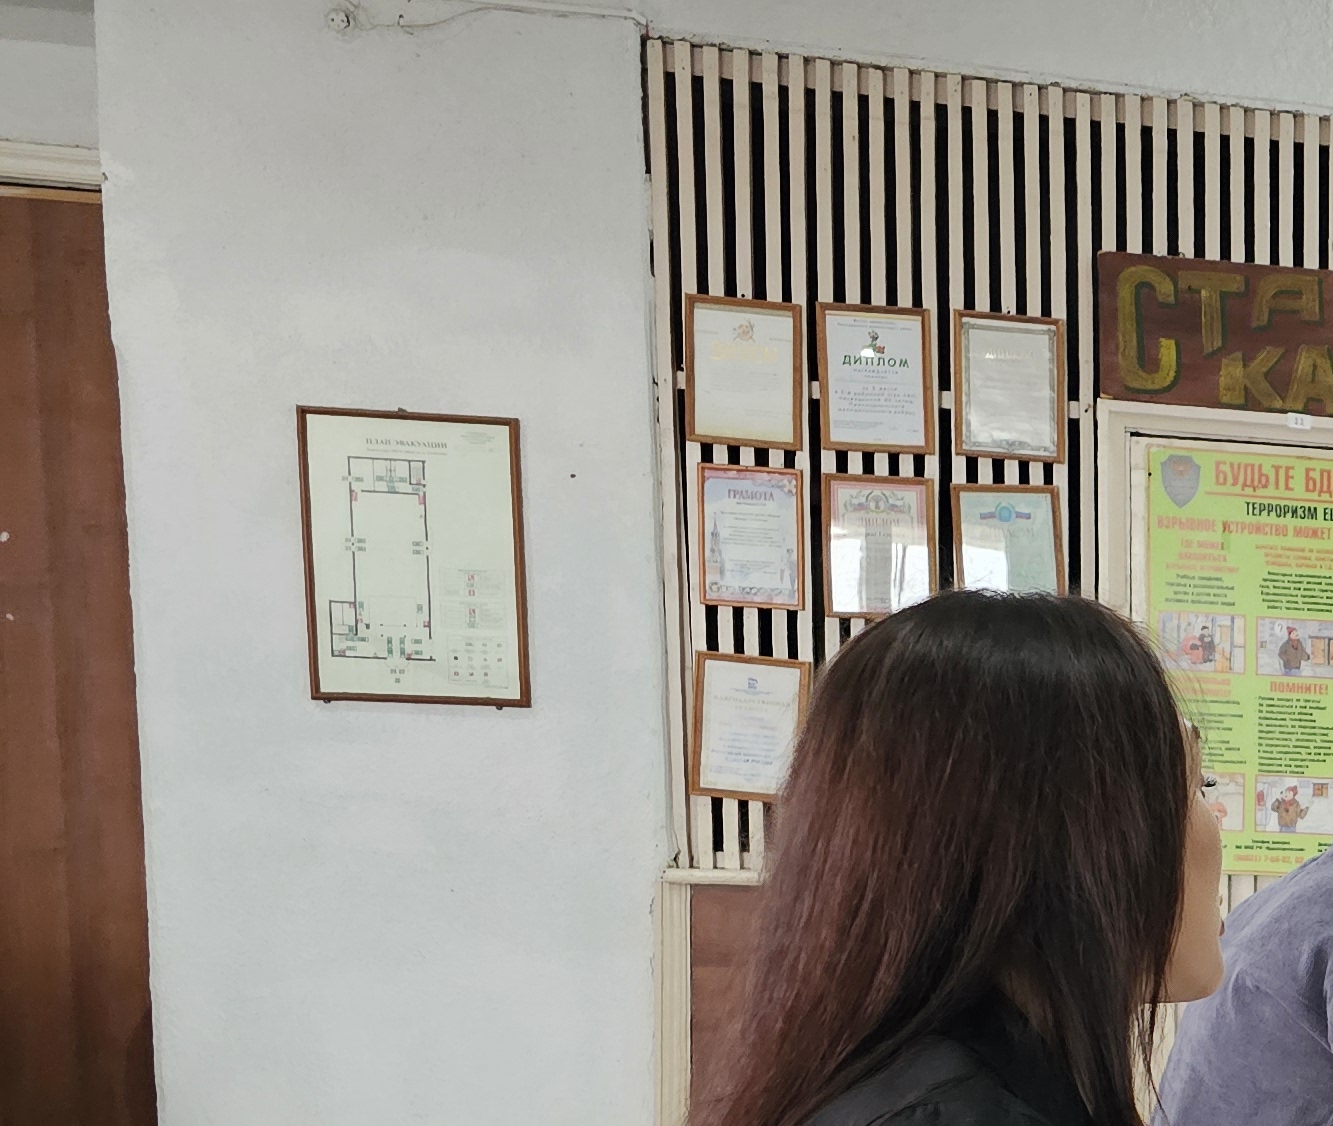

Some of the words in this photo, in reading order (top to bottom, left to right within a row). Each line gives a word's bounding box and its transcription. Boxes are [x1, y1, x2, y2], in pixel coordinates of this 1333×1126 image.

[842, 354, 909, 368] ДИПЛОМ
[1214, 460, 1295, 492] БУДЬТЕ
[727, 488, 775, 502] ГРАМОТА
[1245, 501, 1318, 521] ТЕРРОРИЗМ
[1221, 520, 1288, 537] УСТРОЙСТВО
[1293, 526, 1332, 541] МОЖЕТ
[1269, 681, 1329, 696] ПОМНИТЕ!
